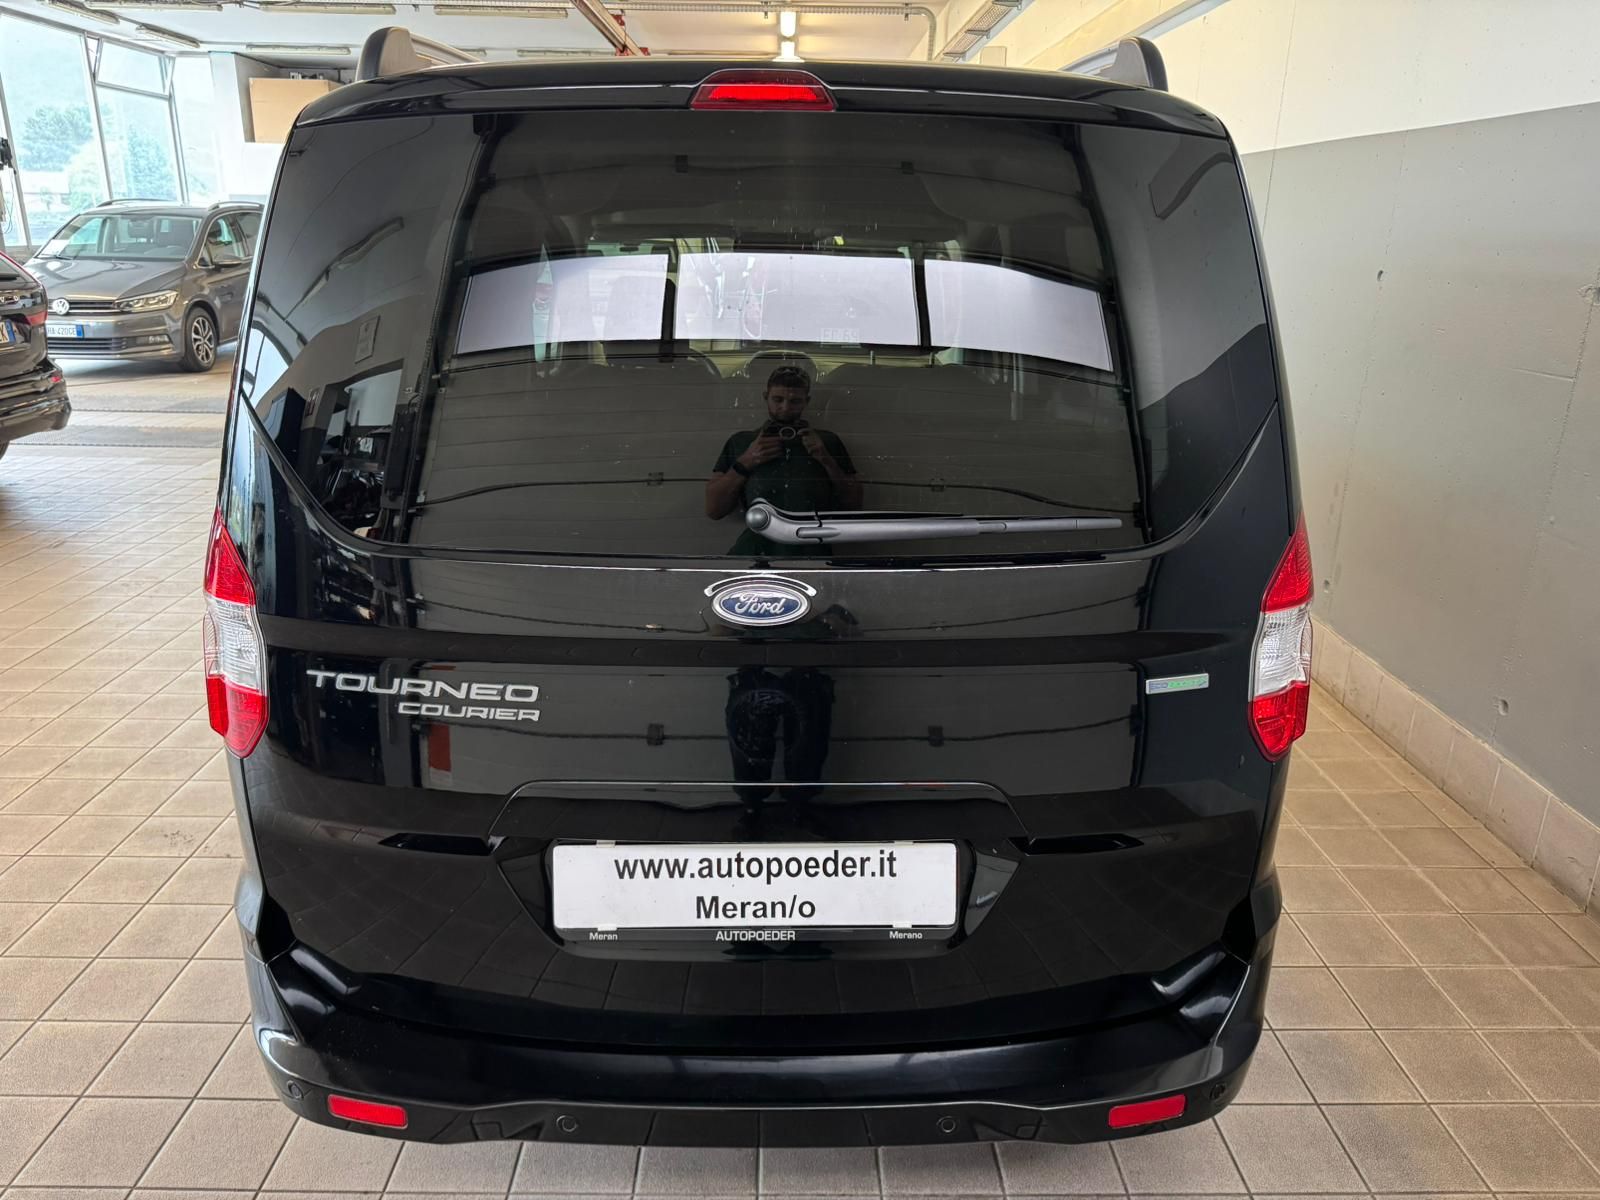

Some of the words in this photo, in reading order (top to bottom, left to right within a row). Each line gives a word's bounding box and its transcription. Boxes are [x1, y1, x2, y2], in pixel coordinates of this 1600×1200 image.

[734, 592, 786, 614] Ford
[306, 669, 539, 702] TOURNEO
[398, 702, 540, 721] COURIER
[614, 849, 897, 885] www.autopoeder.it
[695, 894, 816, 919] Meran/o
[589, 932, 618, 941] Meran
[715, 930, 796, 941] AUTOPOEDER
[889, 930, 923, 939] Merano
